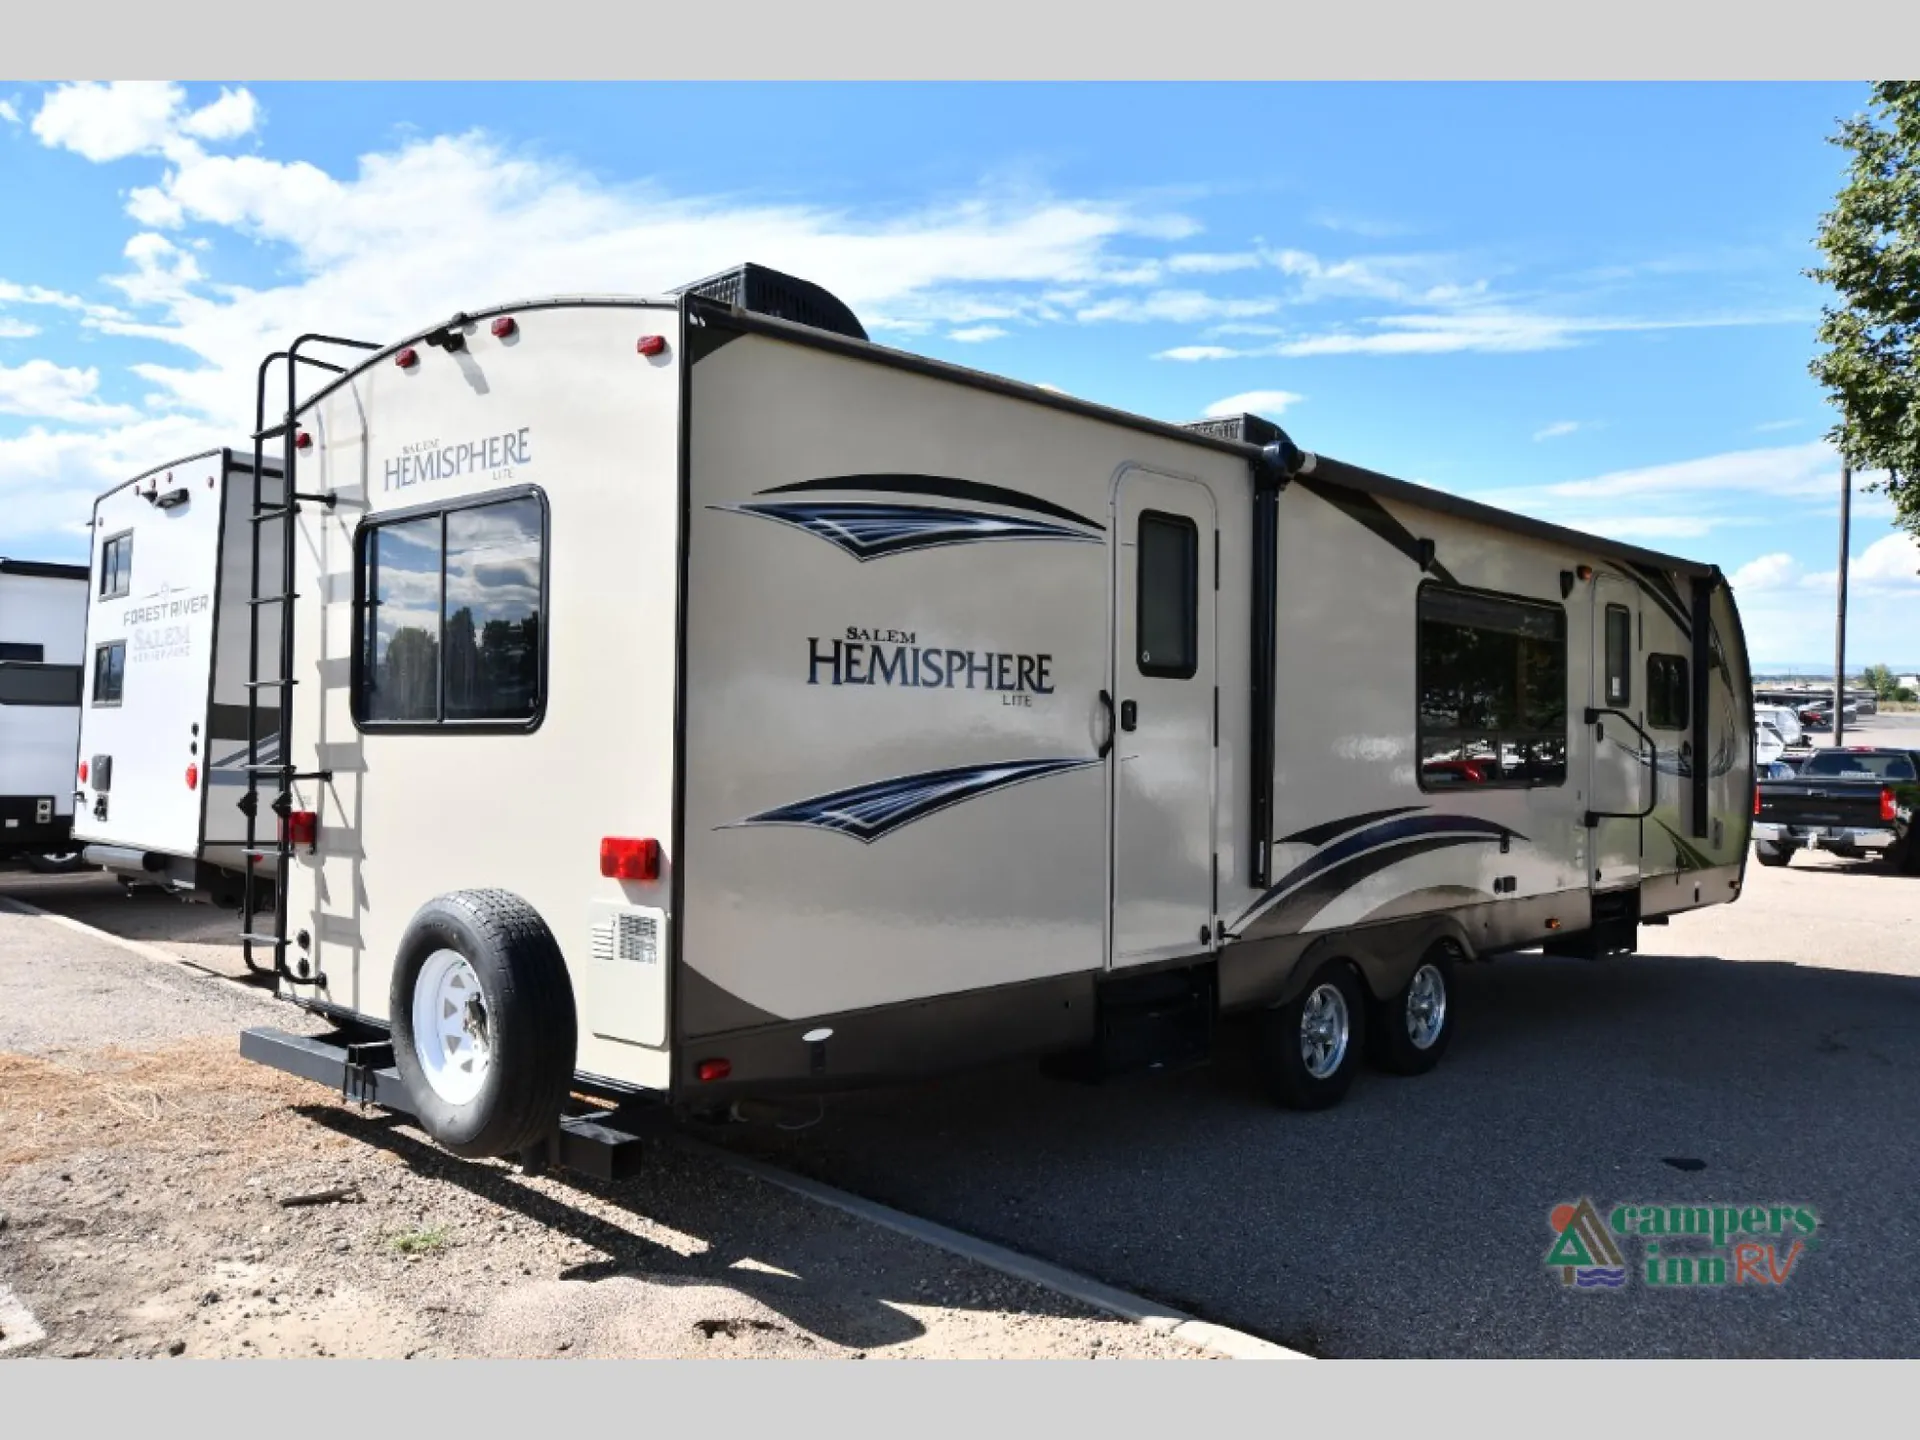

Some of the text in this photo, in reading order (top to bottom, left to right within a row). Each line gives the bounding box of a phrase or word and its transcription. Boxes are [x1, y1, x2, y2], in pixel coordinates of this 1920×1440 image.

[384, 427, 532, 491] HEMISPHERE
[123, 593, 209, 626] FOREST RIVER
[846, 626, 916, 644] SALEM
[806, 636, 1055, 695] HEMISPHERE
[1002, 694, 1032, 707] LITE
